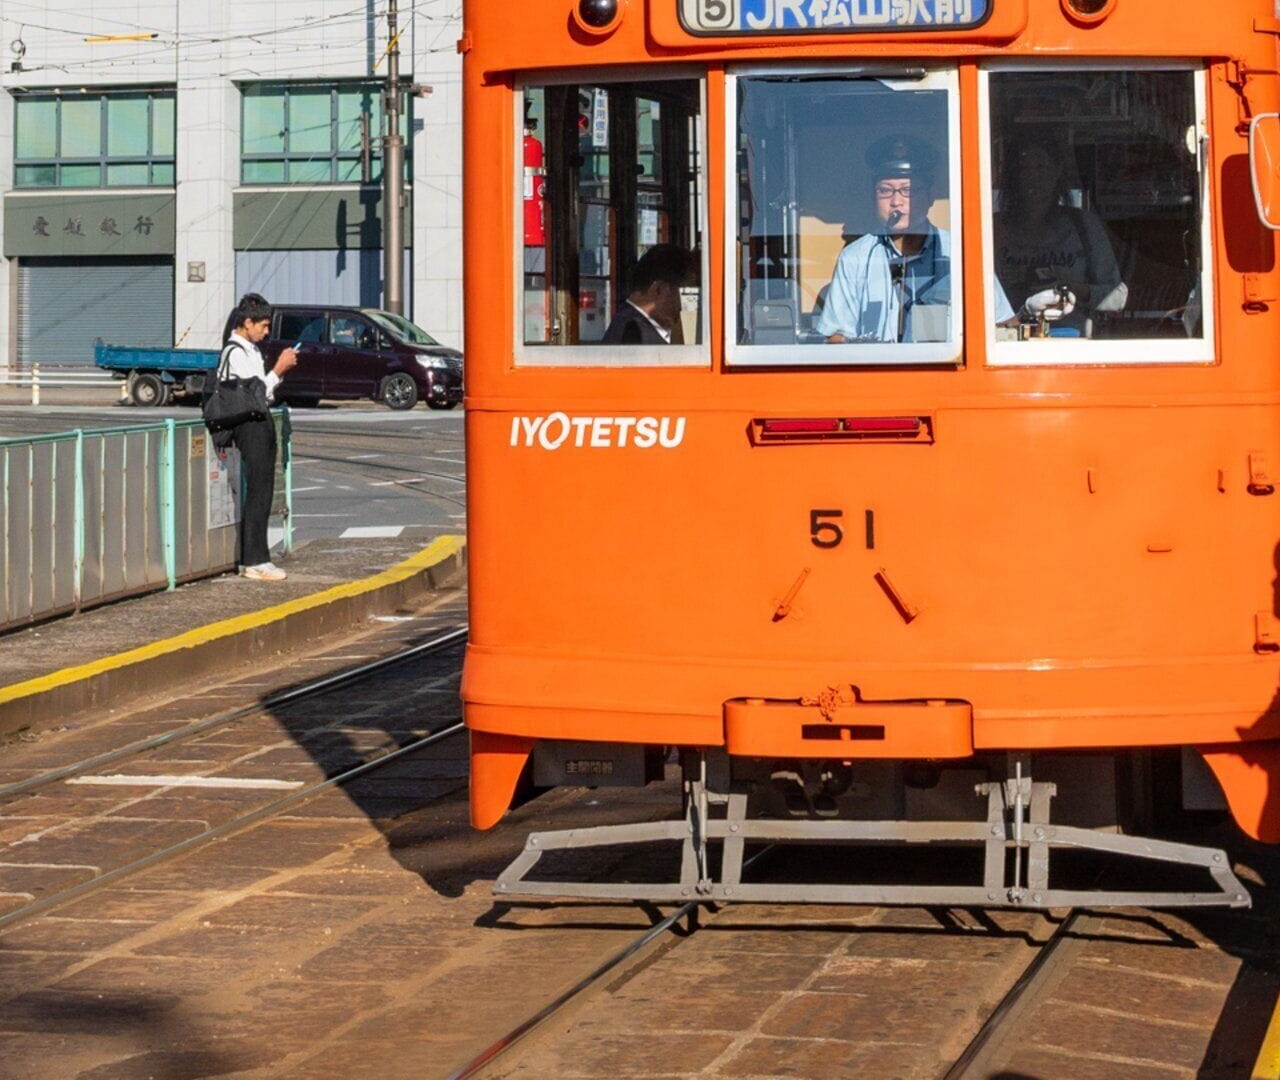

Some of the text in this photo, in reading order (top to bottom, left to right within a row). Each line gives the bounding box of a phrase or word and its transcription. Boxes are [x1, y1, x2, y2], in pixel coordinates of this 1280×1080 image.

[32, 214, 154, 238] 愛媛銀行
[510, 411, 687, 451] IYOTETSU
[810, 509, 875, 550] 51
